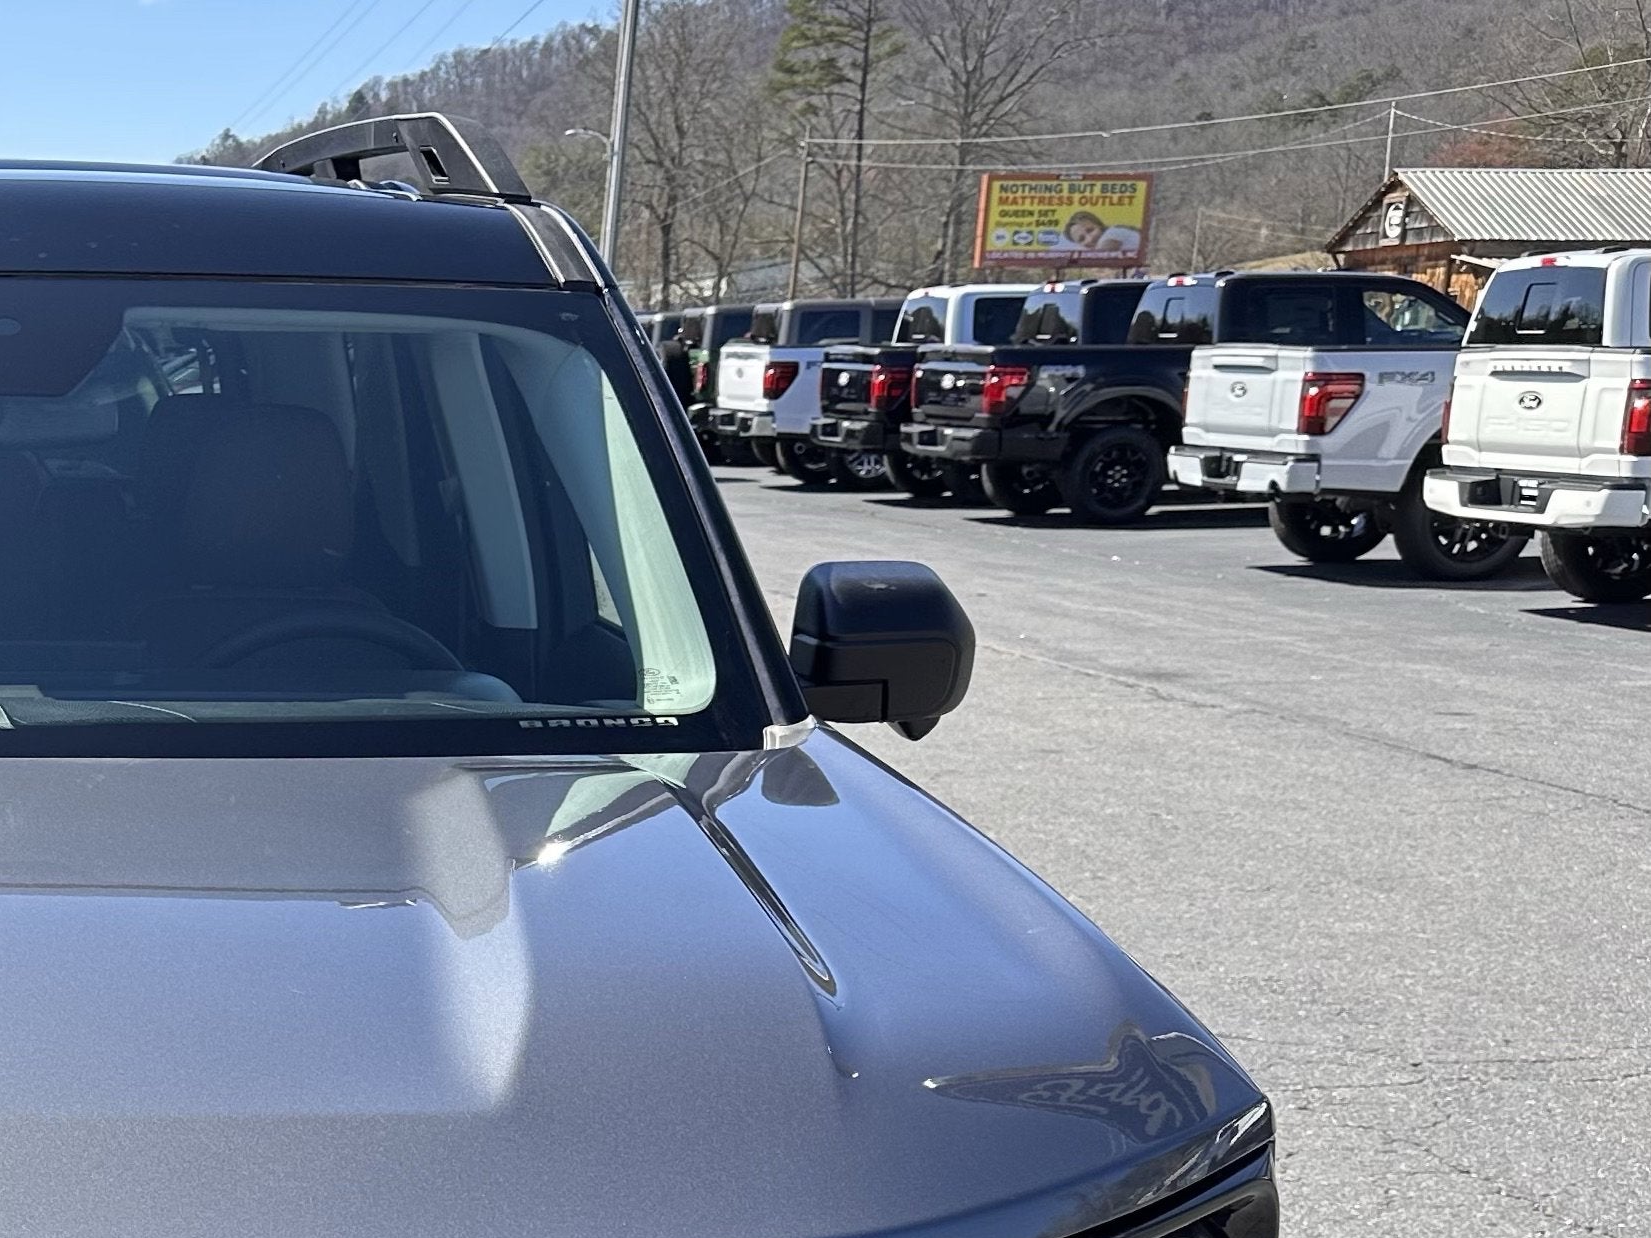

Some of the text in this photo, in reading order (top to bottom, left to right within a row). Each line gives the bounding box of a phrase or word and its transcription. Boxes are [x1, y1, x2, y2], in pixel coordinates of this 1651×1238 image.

[999, 183, 1137, 194] NOTHING BUT BEDS
[998, 195, 1136, 206] MATTRESS OUTLET
[999, 209, 1057, 218] QUEEN SET
[1378, 371, 1435, 386] FX4
[519, 717, 679, 728] BRONCO
